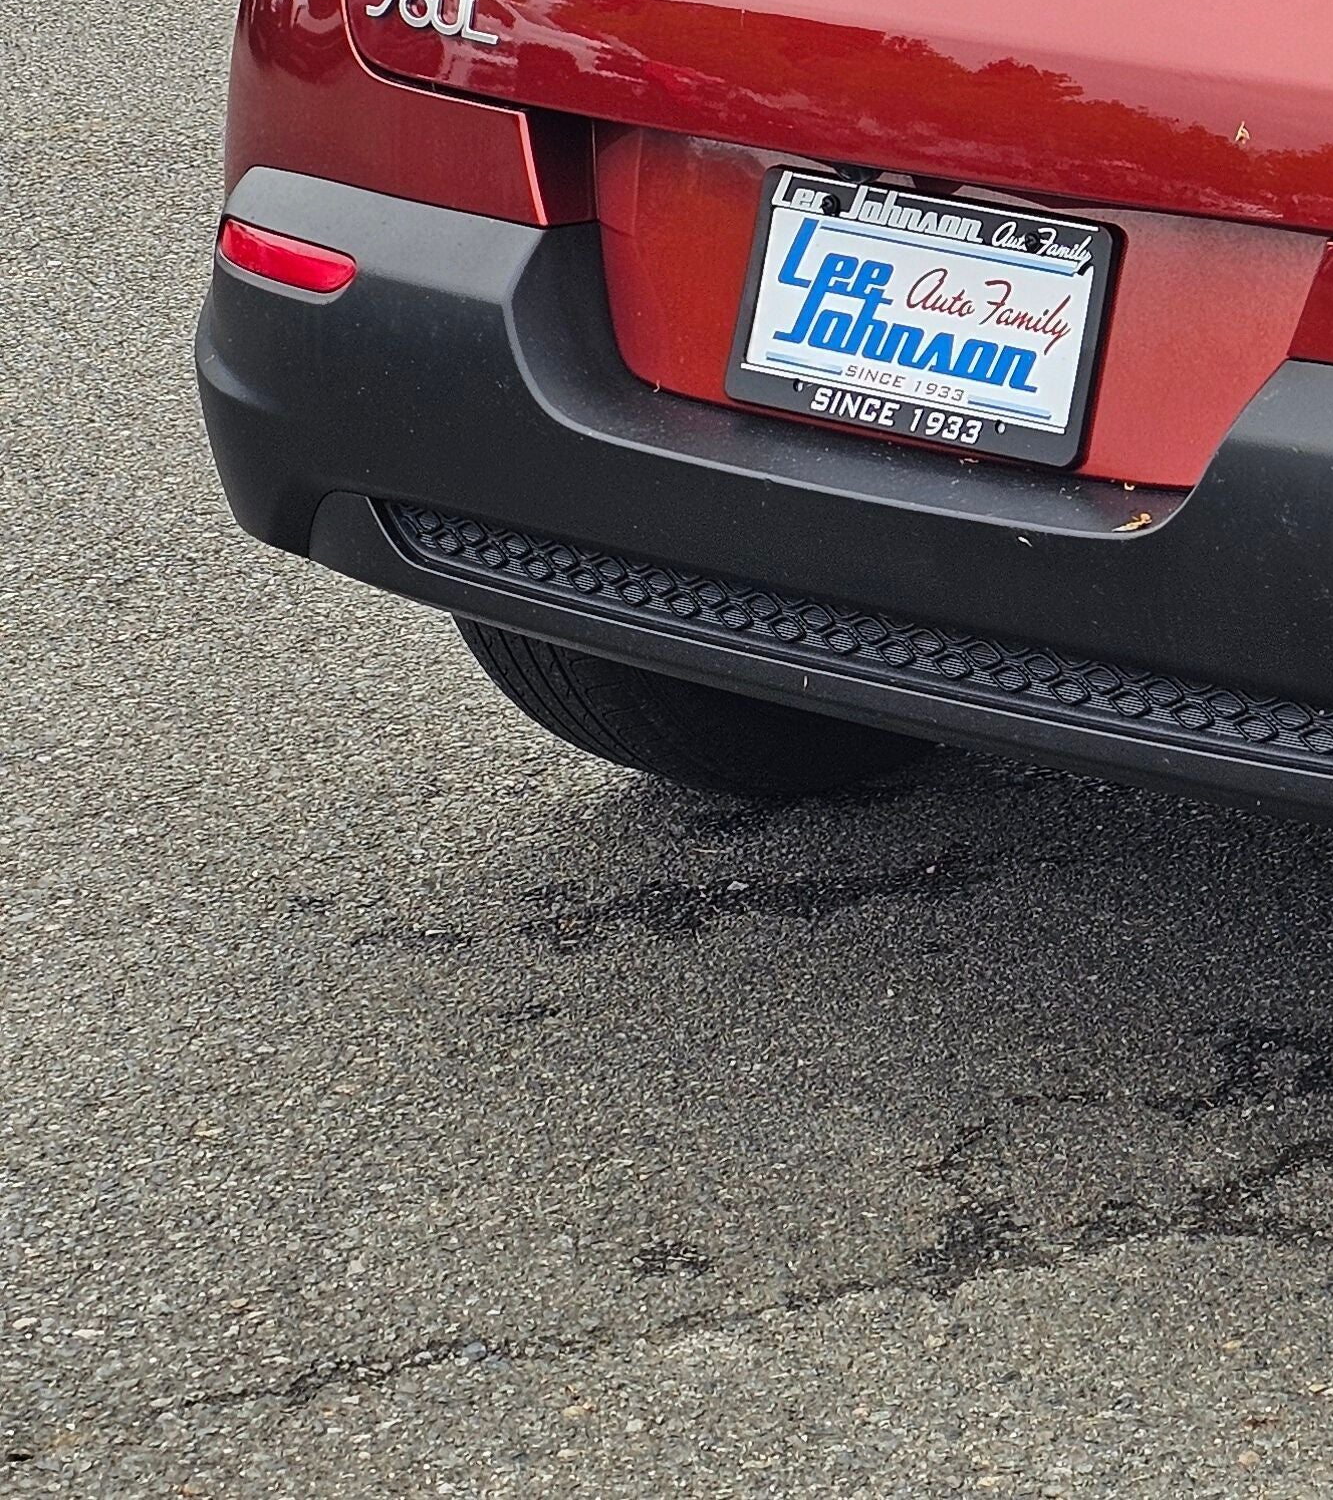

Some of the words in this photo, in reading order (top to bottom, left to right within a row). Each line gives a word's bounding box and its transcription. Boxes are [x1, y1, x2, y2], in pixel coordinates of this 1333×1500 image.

[778, 217, 894, 300] Lee
[839, 185, 983, 244] Johnson
[991, 221, 1032, 251] Aut
[1034, 227, 1092, 274] Family
[773, 288, 1037, 393] Johnson
[906, 267, 976, 317] Auto
[978, 279, 1072, 356] Family
[810, 387, 900, 427] SINCE
[908, 407, 983, 445] 1933
[844, 364, 906, 389] SINCE
[913, 380, 965, 402] 1933
